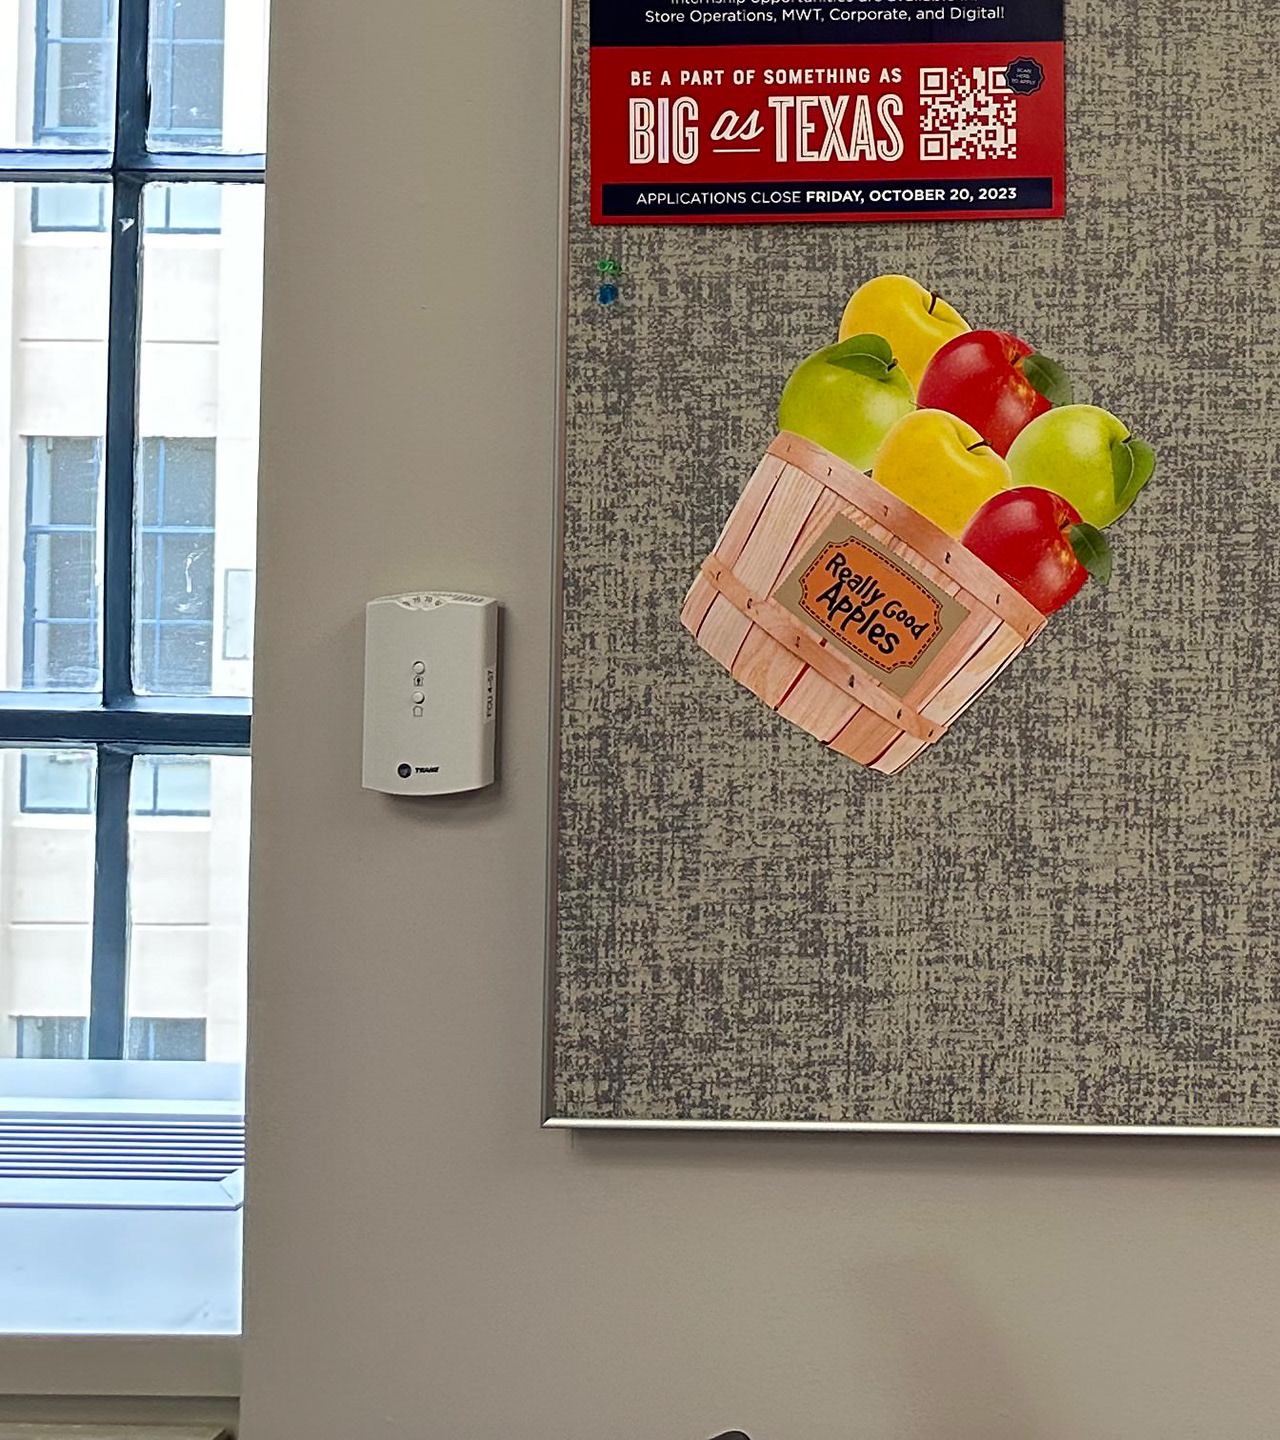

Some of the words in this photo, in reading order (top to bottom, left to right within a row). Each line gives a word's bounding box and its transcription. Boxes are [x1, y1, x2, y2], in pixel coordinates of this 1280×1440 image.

[645, 10, 685, 23] Store
[689, 9, 777, 24] Operations,
[782, 8, 825, 22] MWT,
[829, 8, 911, 22] Corporate,
[915, 7, 945, 20] and
[950, 6, 1005, 22] Digital!
[631, 70, 652, 86] BE
[660, 70, 671, 86] A
[680, 69, 725, 86] PART
[733, 69, 756, 85] OF
[763, 68, 870, 85] SOMETHING
[879, 67, 902, 83] AS
[629, 96, 699, 165] BIG
[710, 109, 765, 141] as
[768, 93, 904, 163] TEXAS
[636, 192, 747, 205] APPLICATIONS
[750, 190, 801, 204] CLOSE
[806, 190, 865, 205] FRIDAY,
[869, 188, 946, 202] OCTOBER
[949, 188, 974, 203] 20,
[978, 187, 1017, 200] 2023
[816, 579, 900, 654] Apples
[825, 552, 885, 608] Really
[883, 600, 930, 640] Good
